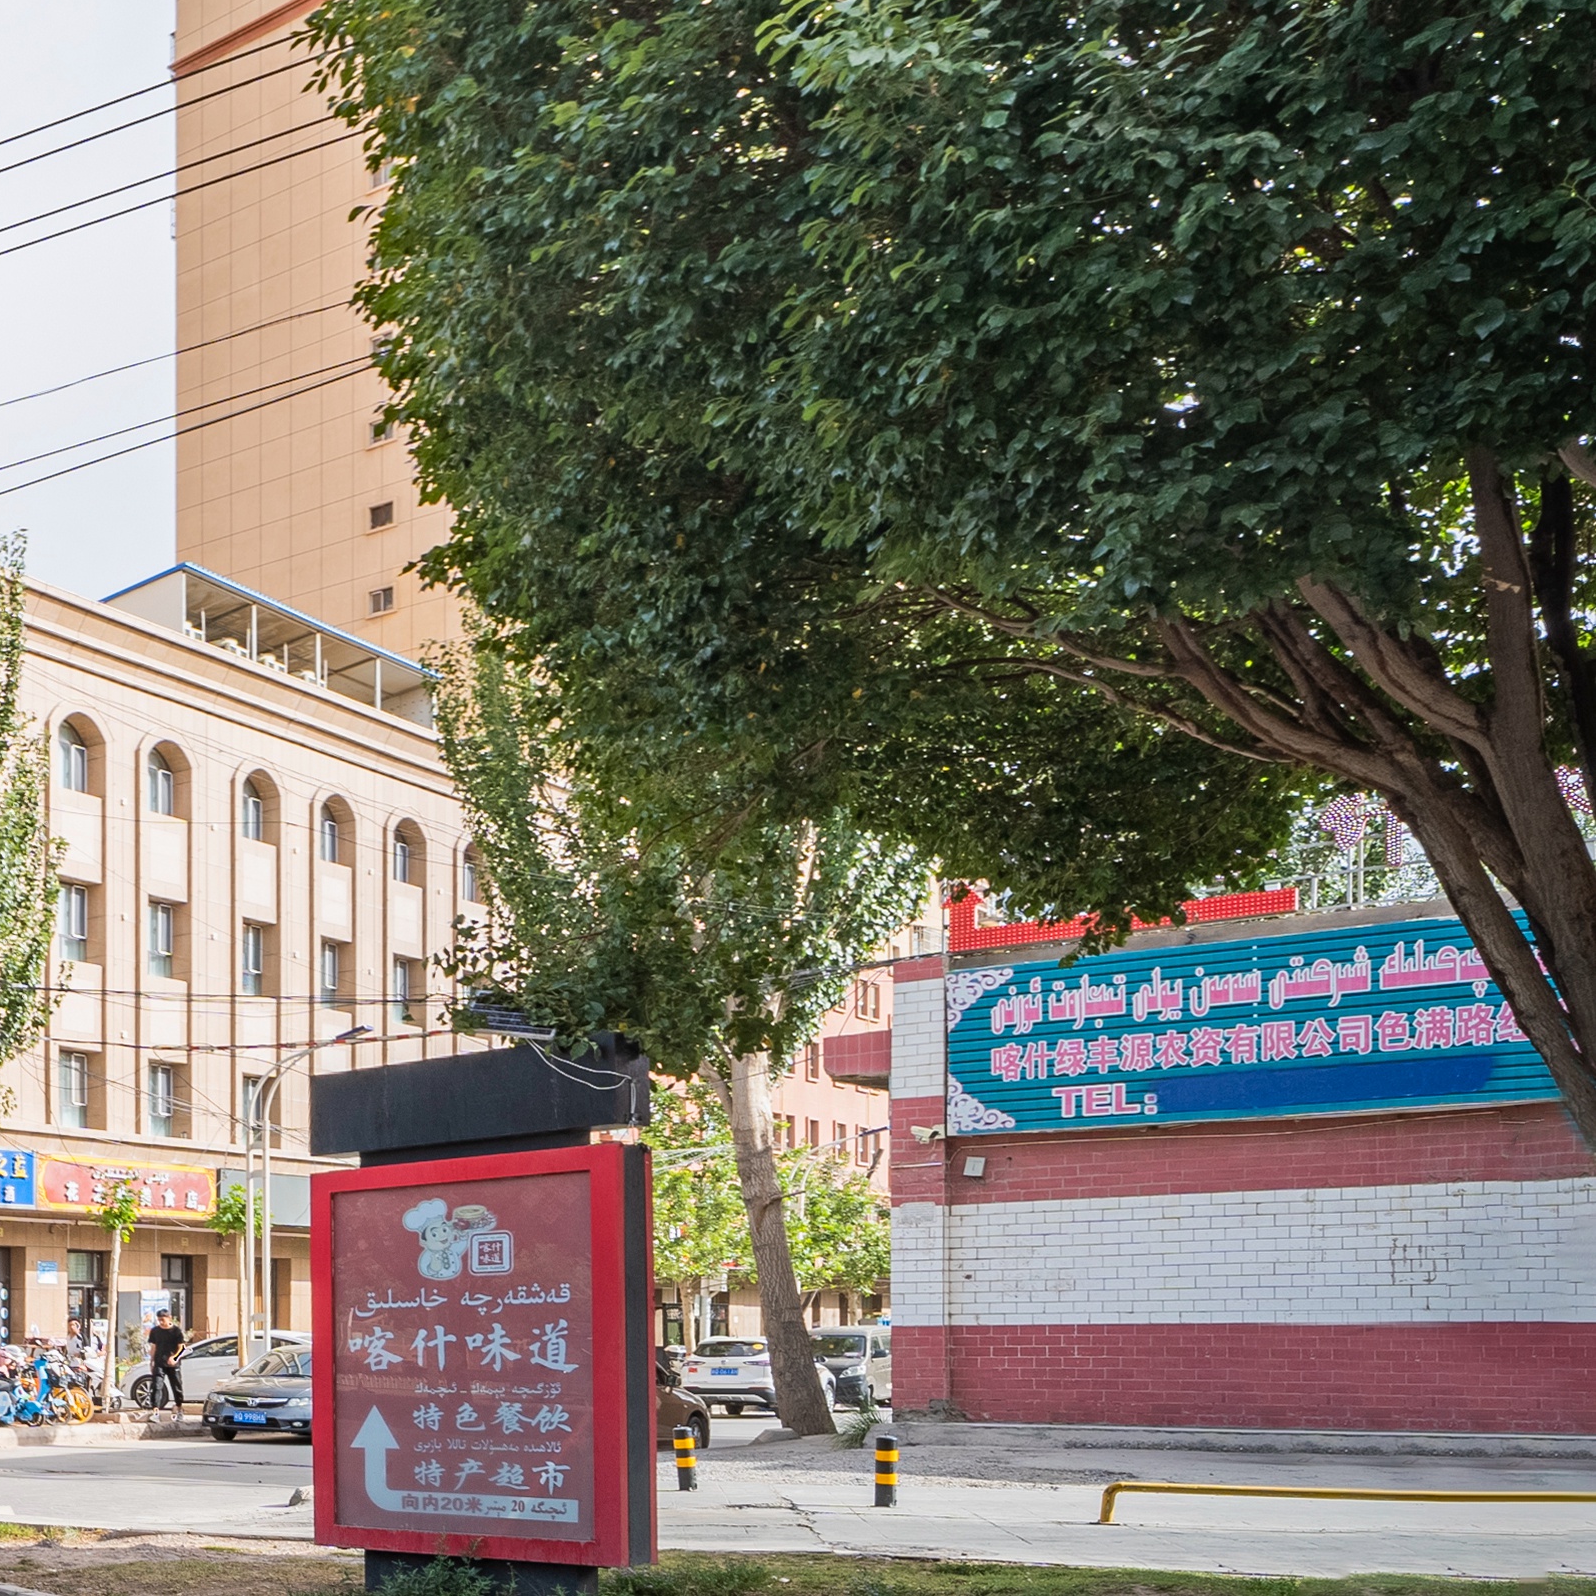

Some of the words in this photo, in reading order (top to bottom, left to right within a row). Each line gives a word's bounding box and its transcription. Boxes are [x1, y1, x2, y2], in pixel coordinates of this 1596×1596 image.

[348, 1318, 580, 1374] 喀什味道
[412, 1402, 573, 1435] 特色餐饮
[413, 1458, 572, 1496] 特产超市
